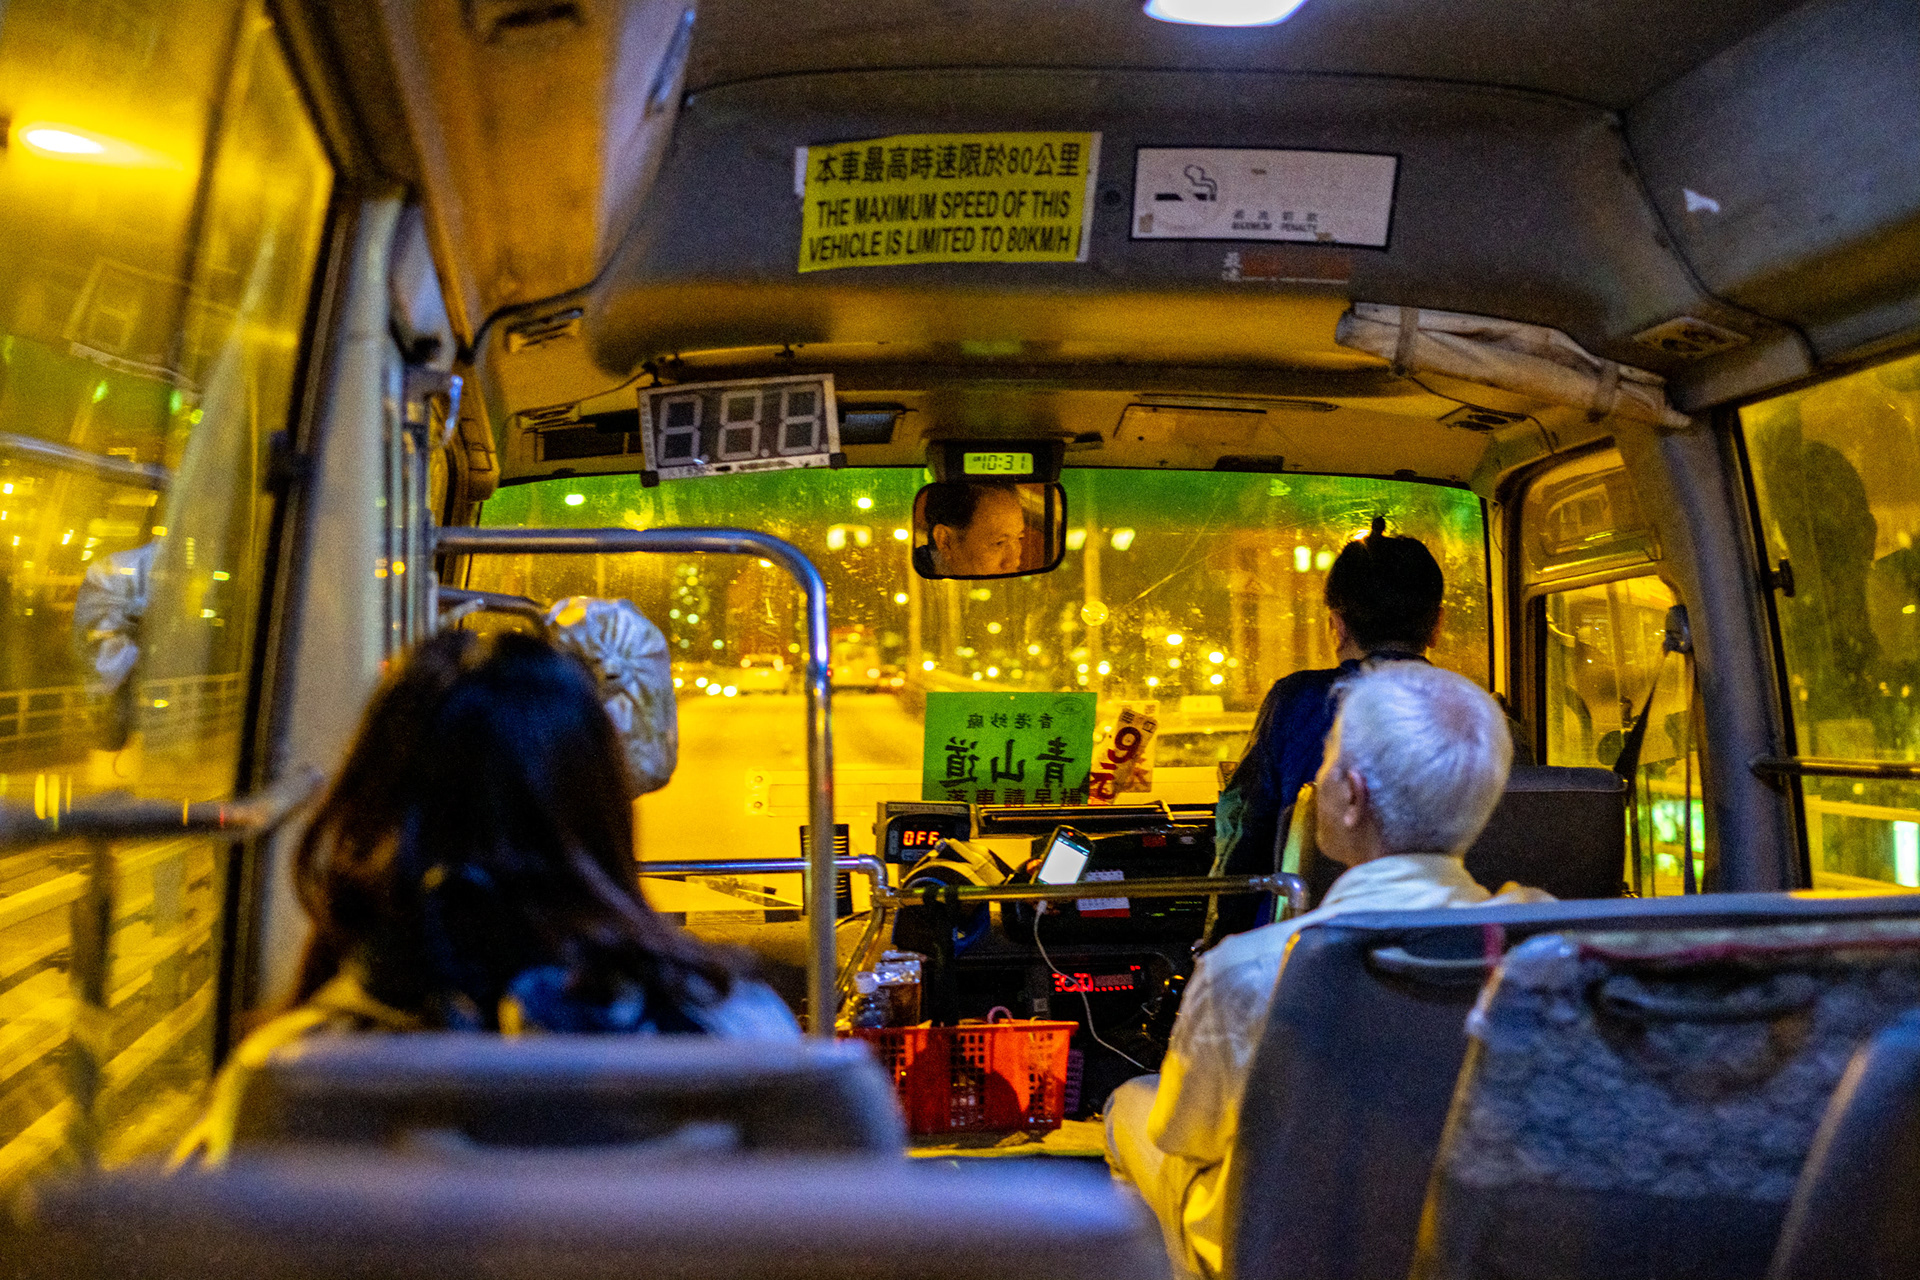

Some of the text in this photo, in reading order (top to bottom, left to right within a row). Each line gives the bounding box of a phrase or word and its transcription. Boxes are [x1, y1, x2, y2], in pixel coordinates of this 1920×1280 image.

[815, 142, 1081, 184] 本車最高時速限於80公里
[816, 190, 1071, 228] THE MAXIMUM SPEED OF THIS
[808, 230, 883, 262] VEHICLE
[886, 229, 903, 255] IS
[906, 226, 976, 254] LIMITED
[979, 226, 1003, 251] TO
[981, 455, 1026, 470] 10:31
[903, 830, 940, 846] OFF
